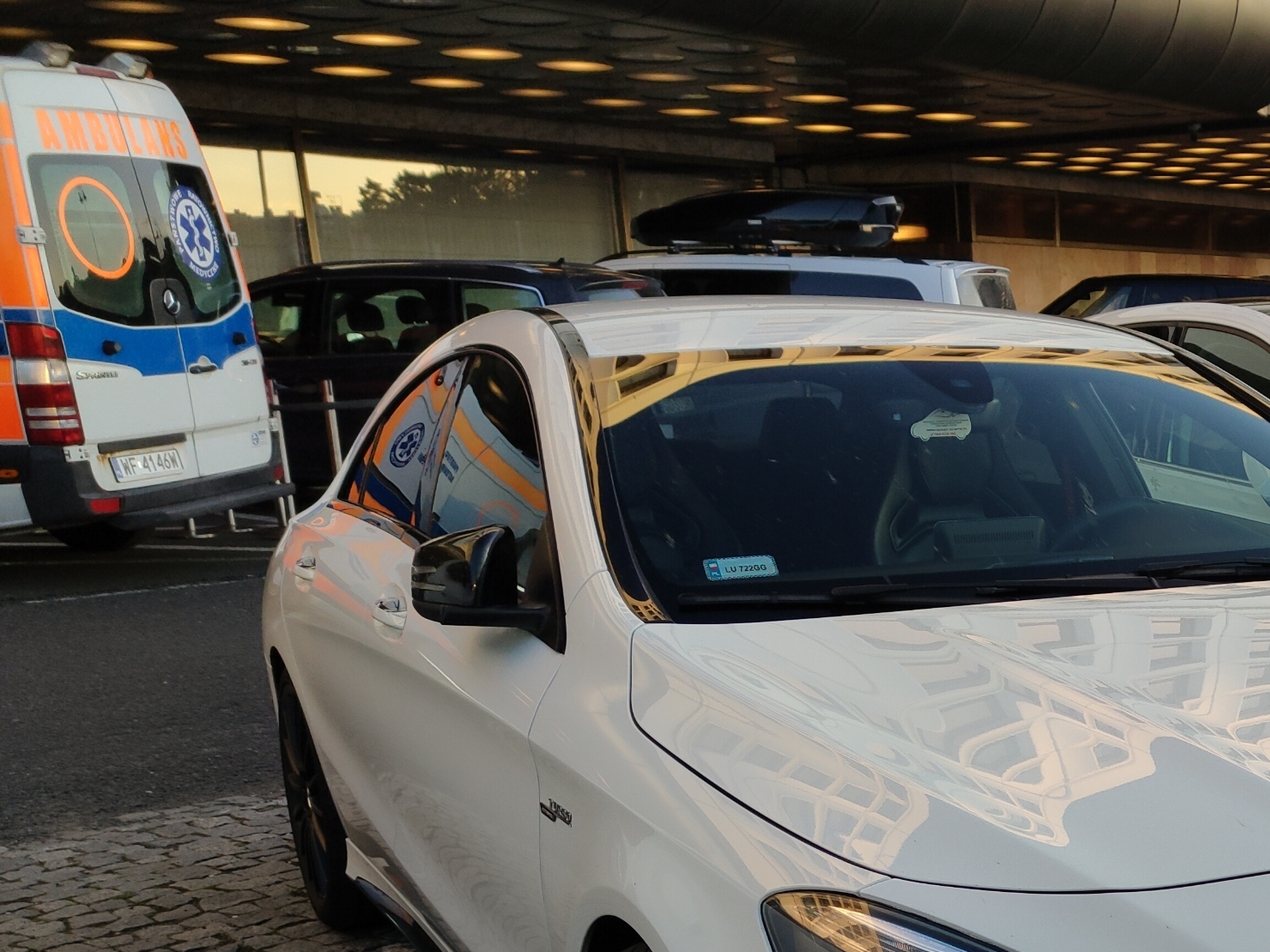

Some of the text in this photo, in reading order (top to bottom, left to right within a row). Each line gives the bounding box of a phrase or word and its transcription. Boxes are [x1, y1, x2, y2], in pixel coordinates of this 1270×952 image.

[34, 107, 188, 160] AMBULANS
[120, 451, 179, 476] WF 4146W
[739, 564, 768, 572] 722GG
